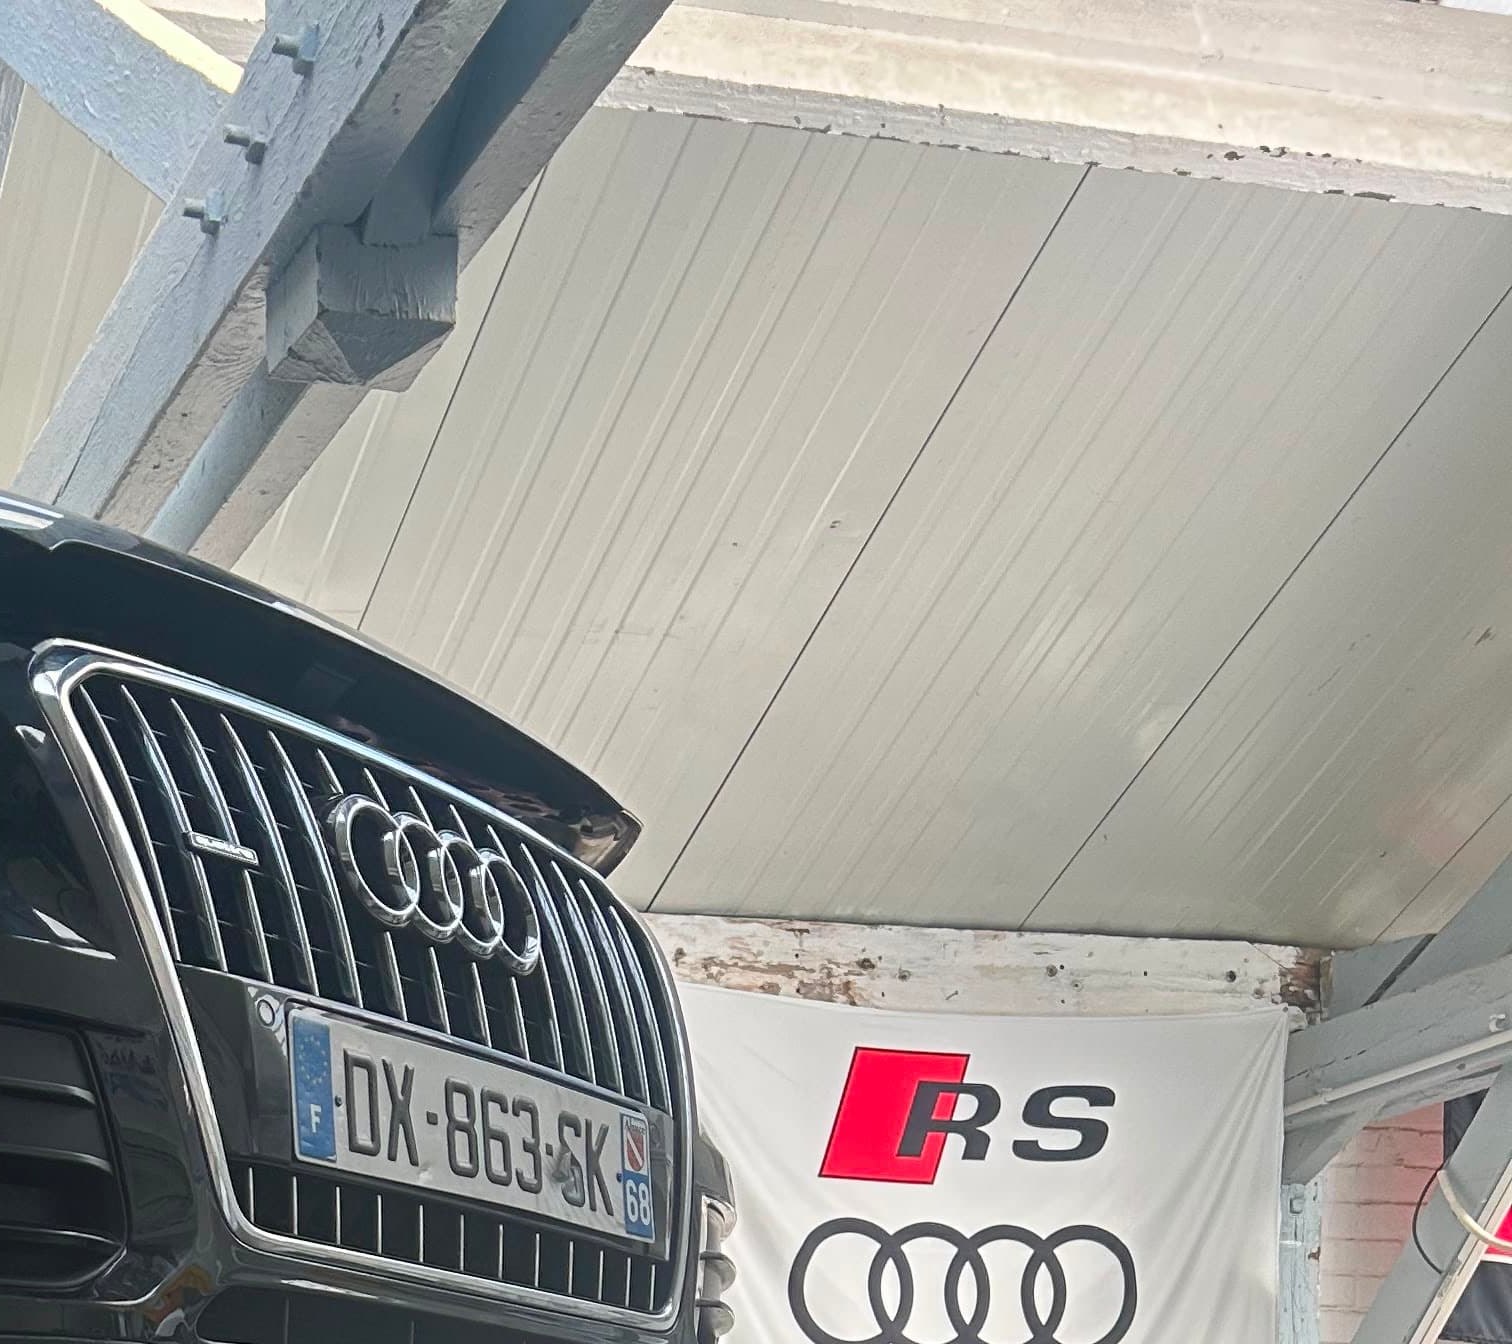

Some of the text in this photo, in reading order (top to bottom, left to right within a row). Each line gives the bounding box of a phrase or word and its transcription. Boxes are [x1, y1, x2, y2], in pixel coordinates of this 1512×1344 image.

[308, 1103, 324, 1135] F
[896, 1081, 1117, 1162] RS
[625, 1179, 651, 1226] 68
